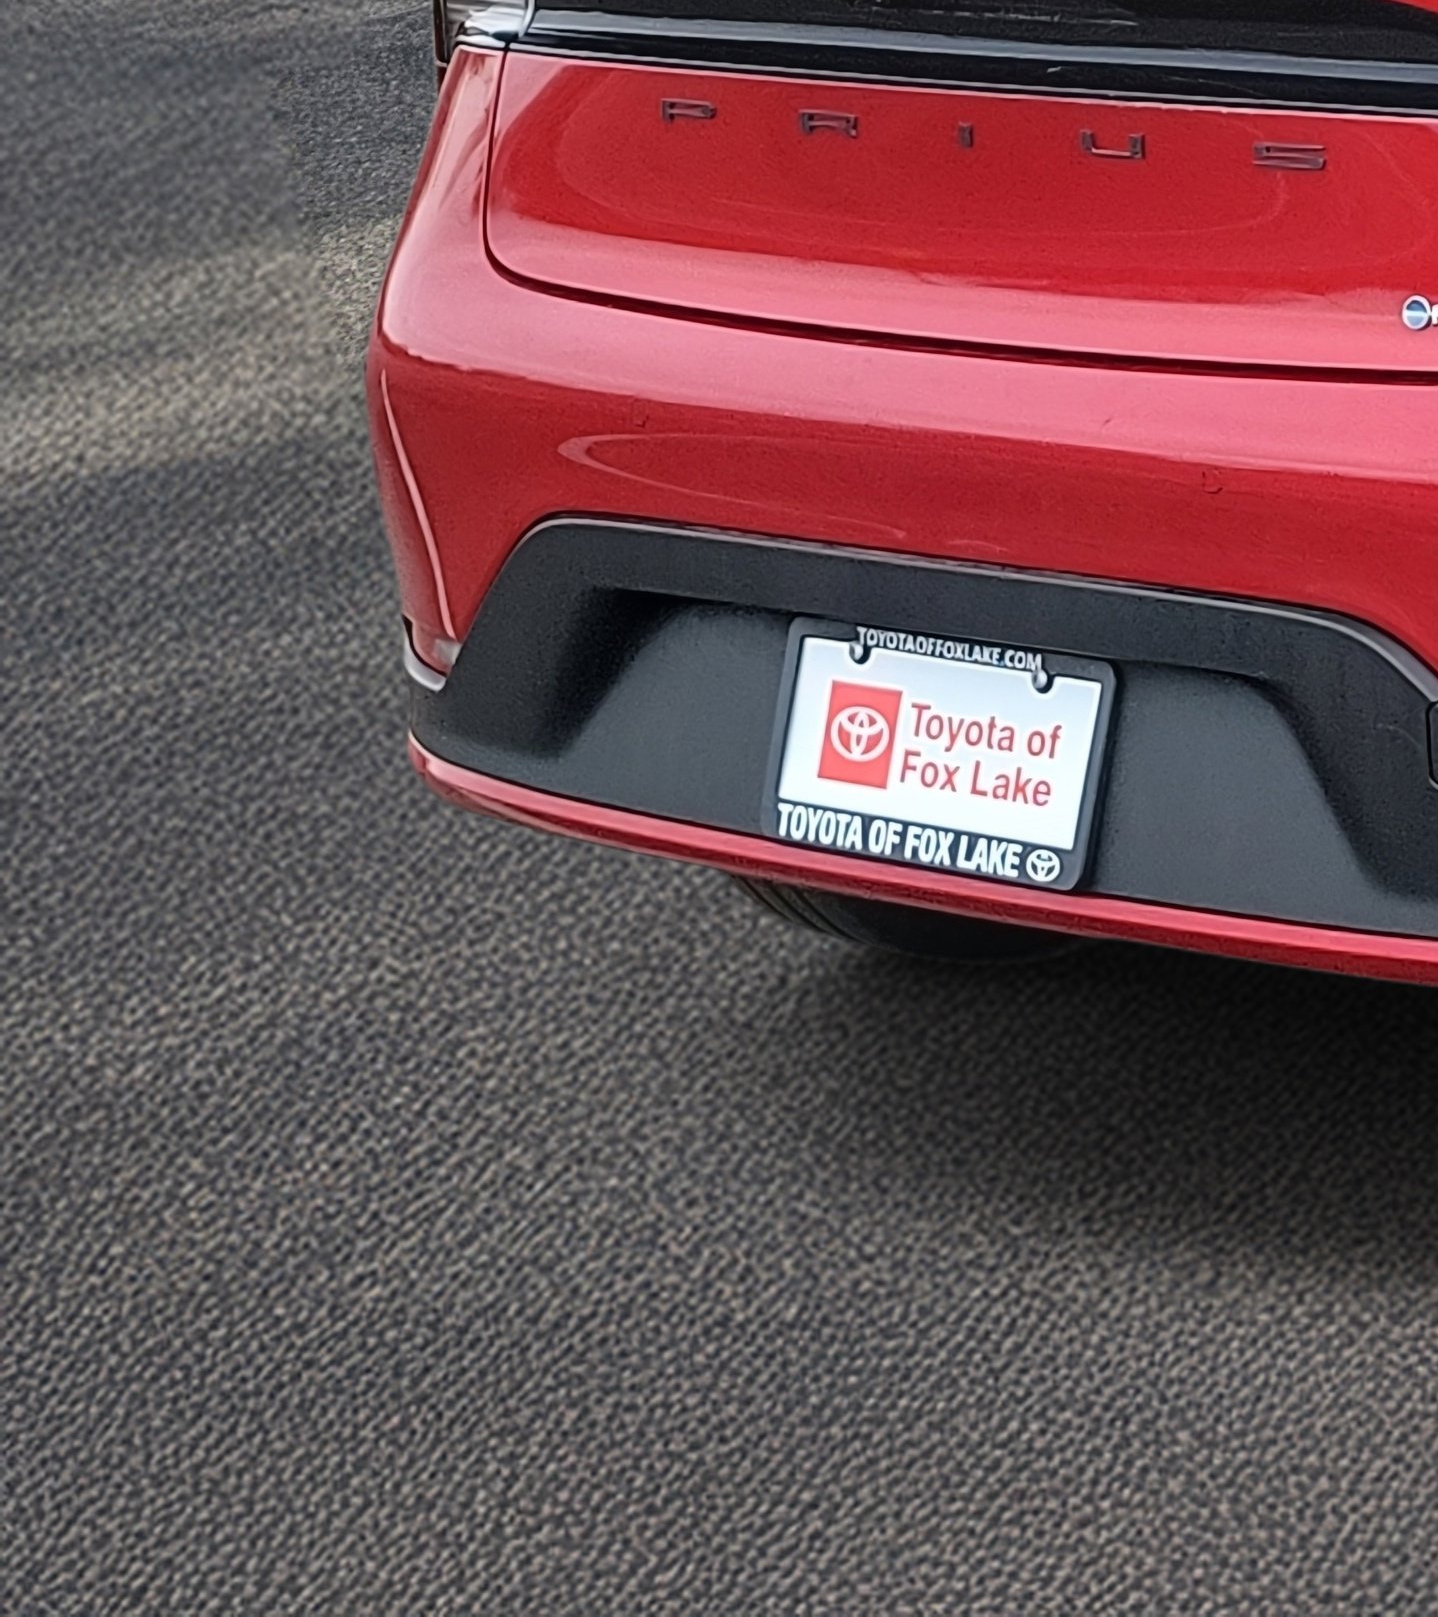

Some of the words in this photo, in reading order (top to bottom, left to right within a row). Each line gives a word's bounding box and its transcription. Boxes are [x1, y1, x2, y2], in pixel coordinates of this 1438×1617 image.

[662, 99, 1326, 170] PRIUS
[857, 626, 1042, 673] TOYOTAOFFOXLAKE.COM
[911, 702, 1015, 753] Toyota
[1026, 724, 1063, 759] of
[898, 749, 962, 793] Fox
[969, 760, 1053, 807] Lake
[777, 802, 864, 851] TOYOTA
[868, 819, 902, 857] OF
[904, 824, 954, 867] FOX
[955, 833, 1024, 879] LAKE
